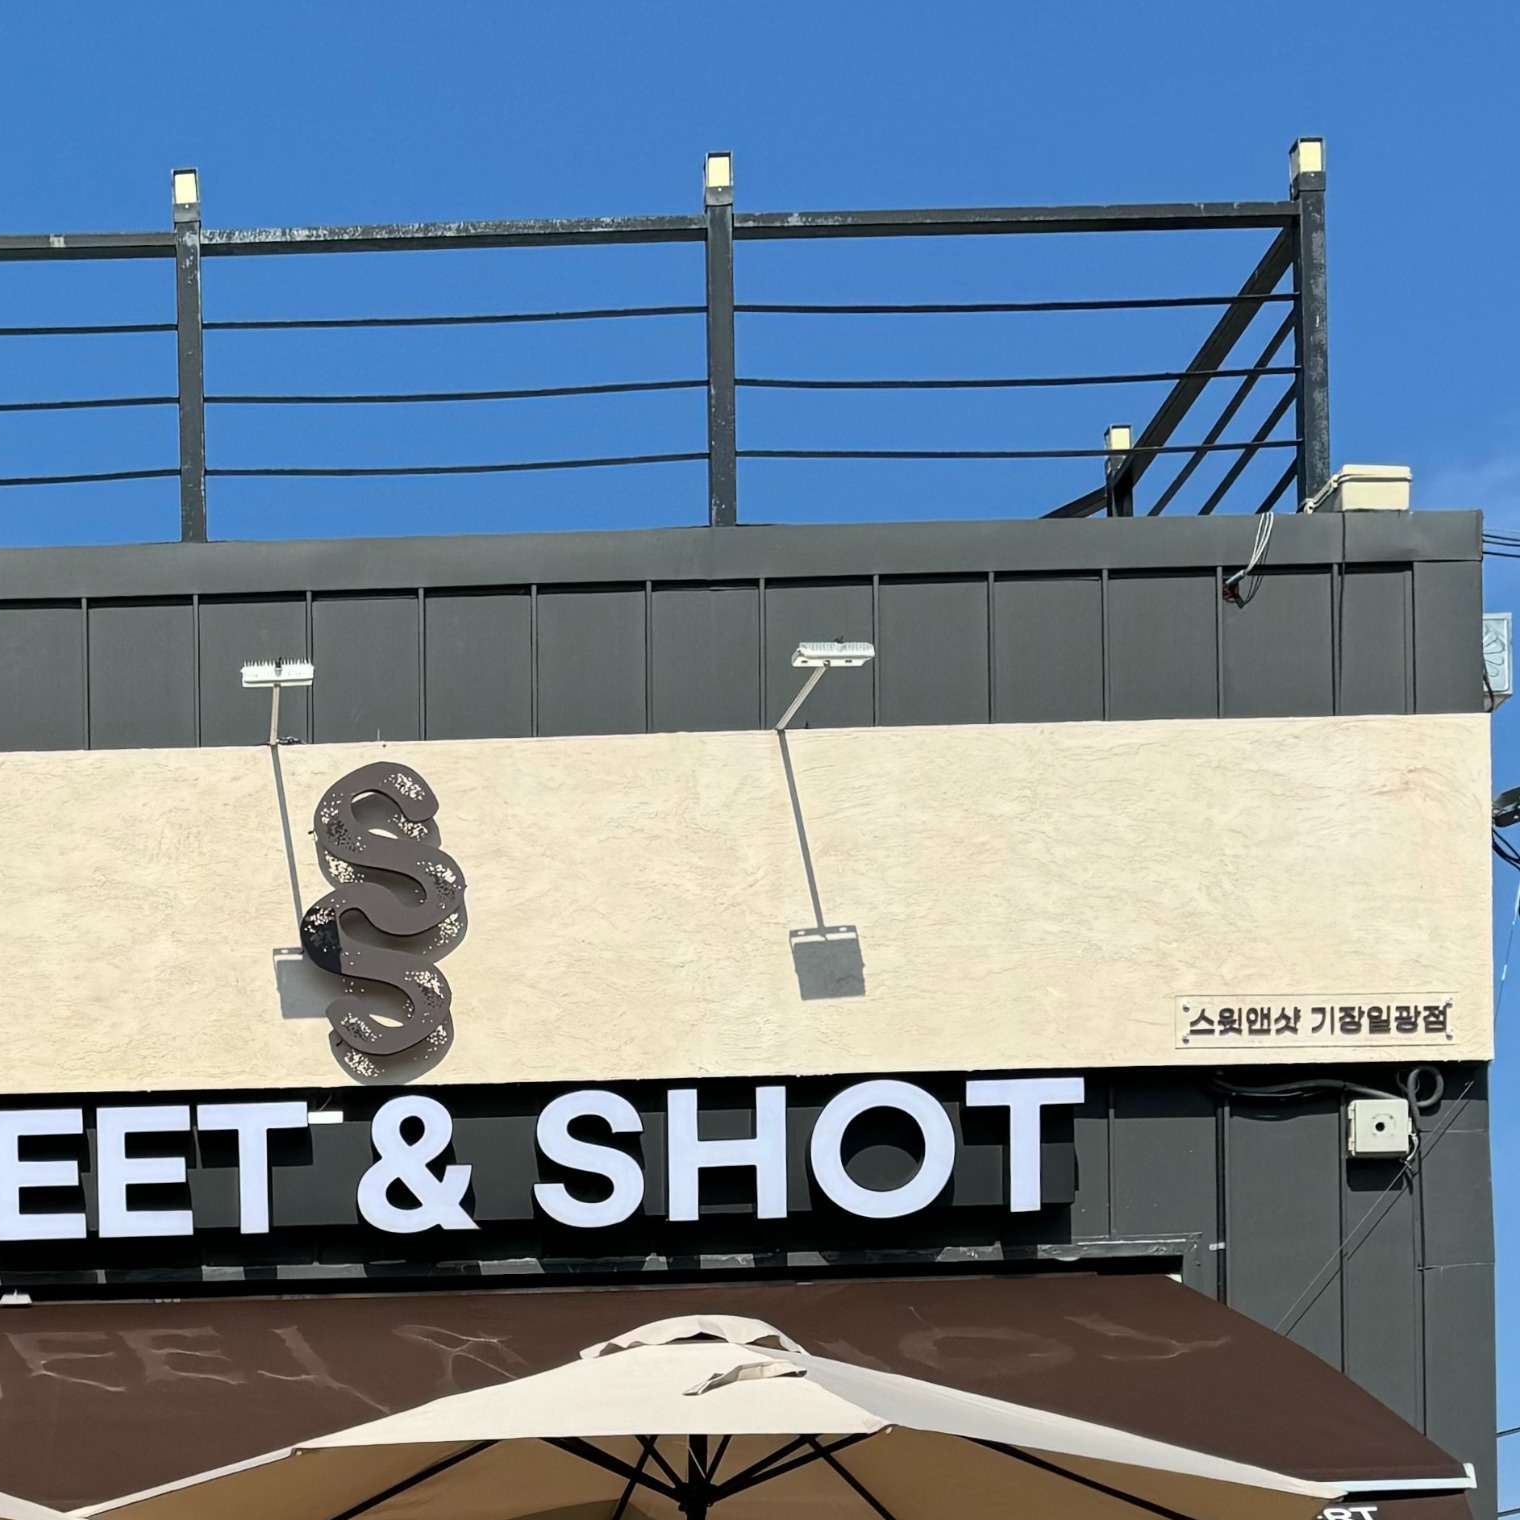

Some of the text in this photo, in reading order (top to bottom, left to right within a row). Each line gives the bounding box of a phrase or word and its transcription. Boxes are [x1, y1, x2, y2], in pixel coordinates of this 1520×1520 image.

[1189, 1005, 1448, 1035] 스윗앤샷 기장일광점
[356, 1094, 480, 1234] &
[533, 1077, 1086, 1230] SHOT
